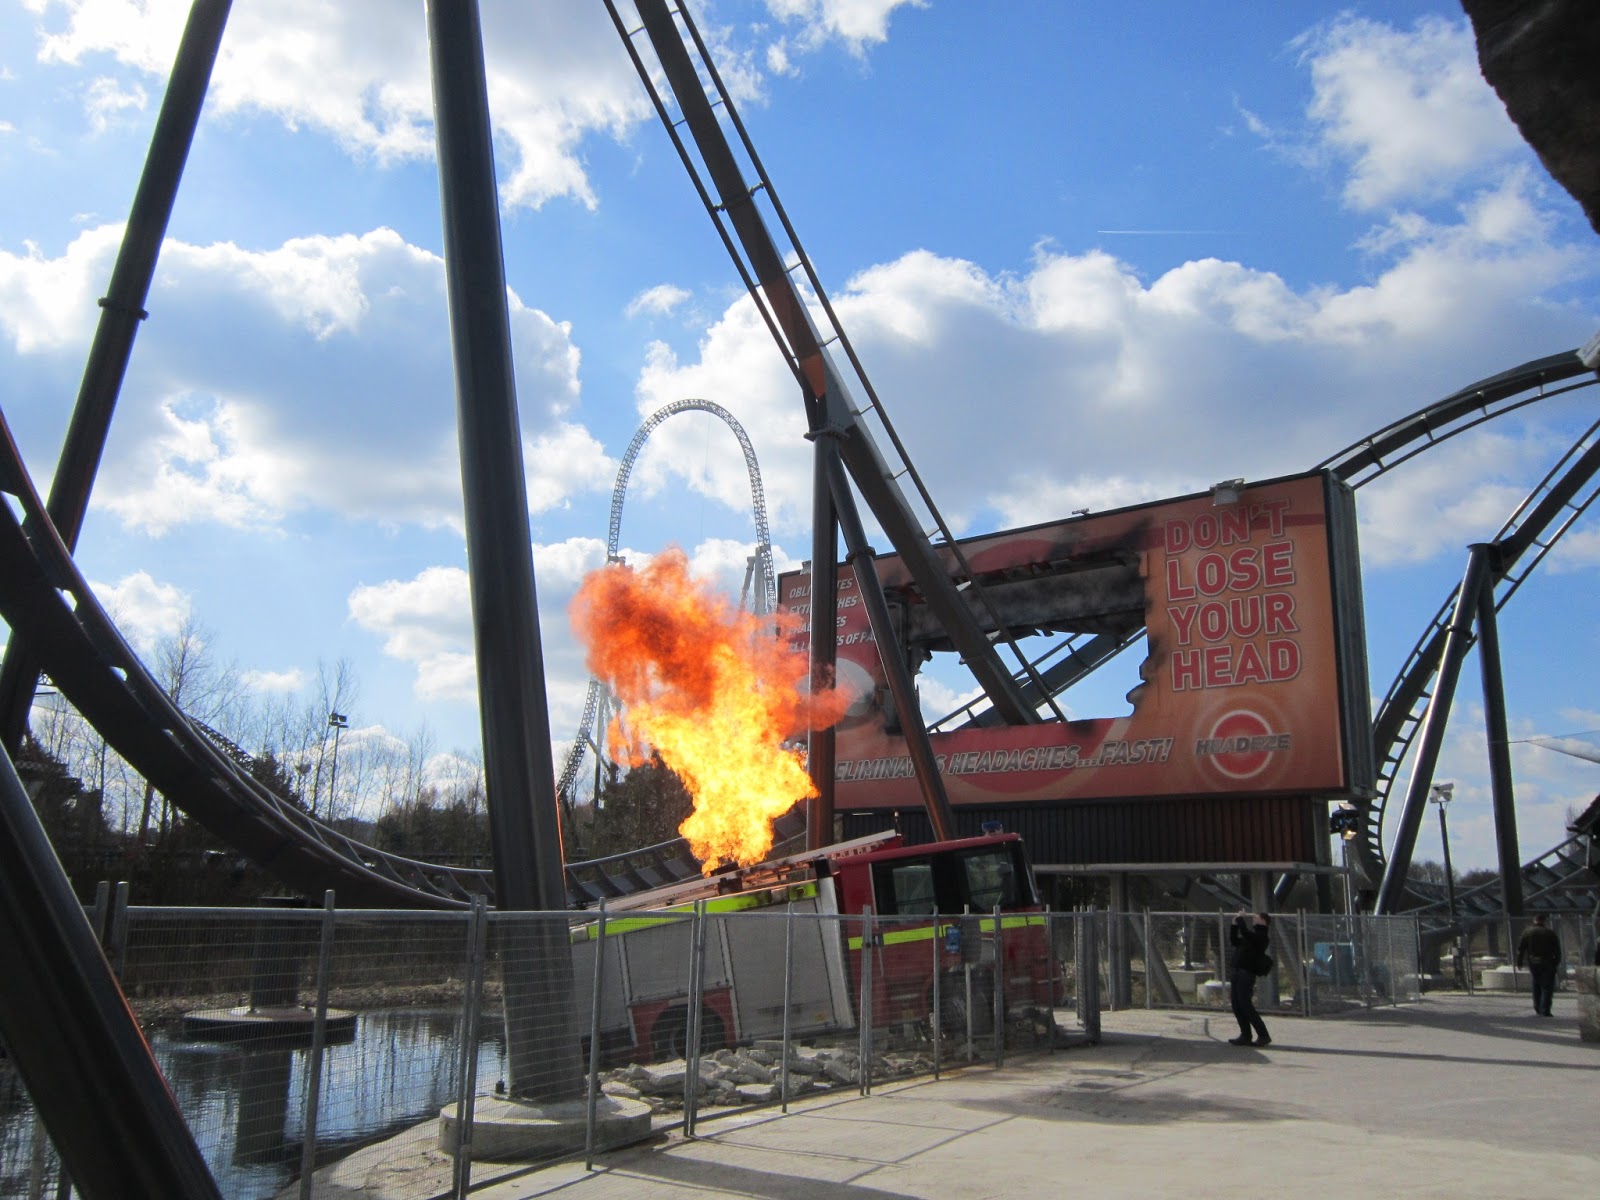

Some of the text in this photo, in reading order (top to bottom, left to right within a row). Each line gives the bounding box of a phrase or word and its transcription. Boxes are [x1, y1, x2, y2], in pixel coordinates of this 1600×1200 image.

[1165, 499, 1290, 555] DON'T
[1166, 540, 1295, 601] LOSE
[845, 633, 860, 645] OF
[1168, 592, 1298, 645] YOUR
[1172, 639, 1301, 691] HEAD
